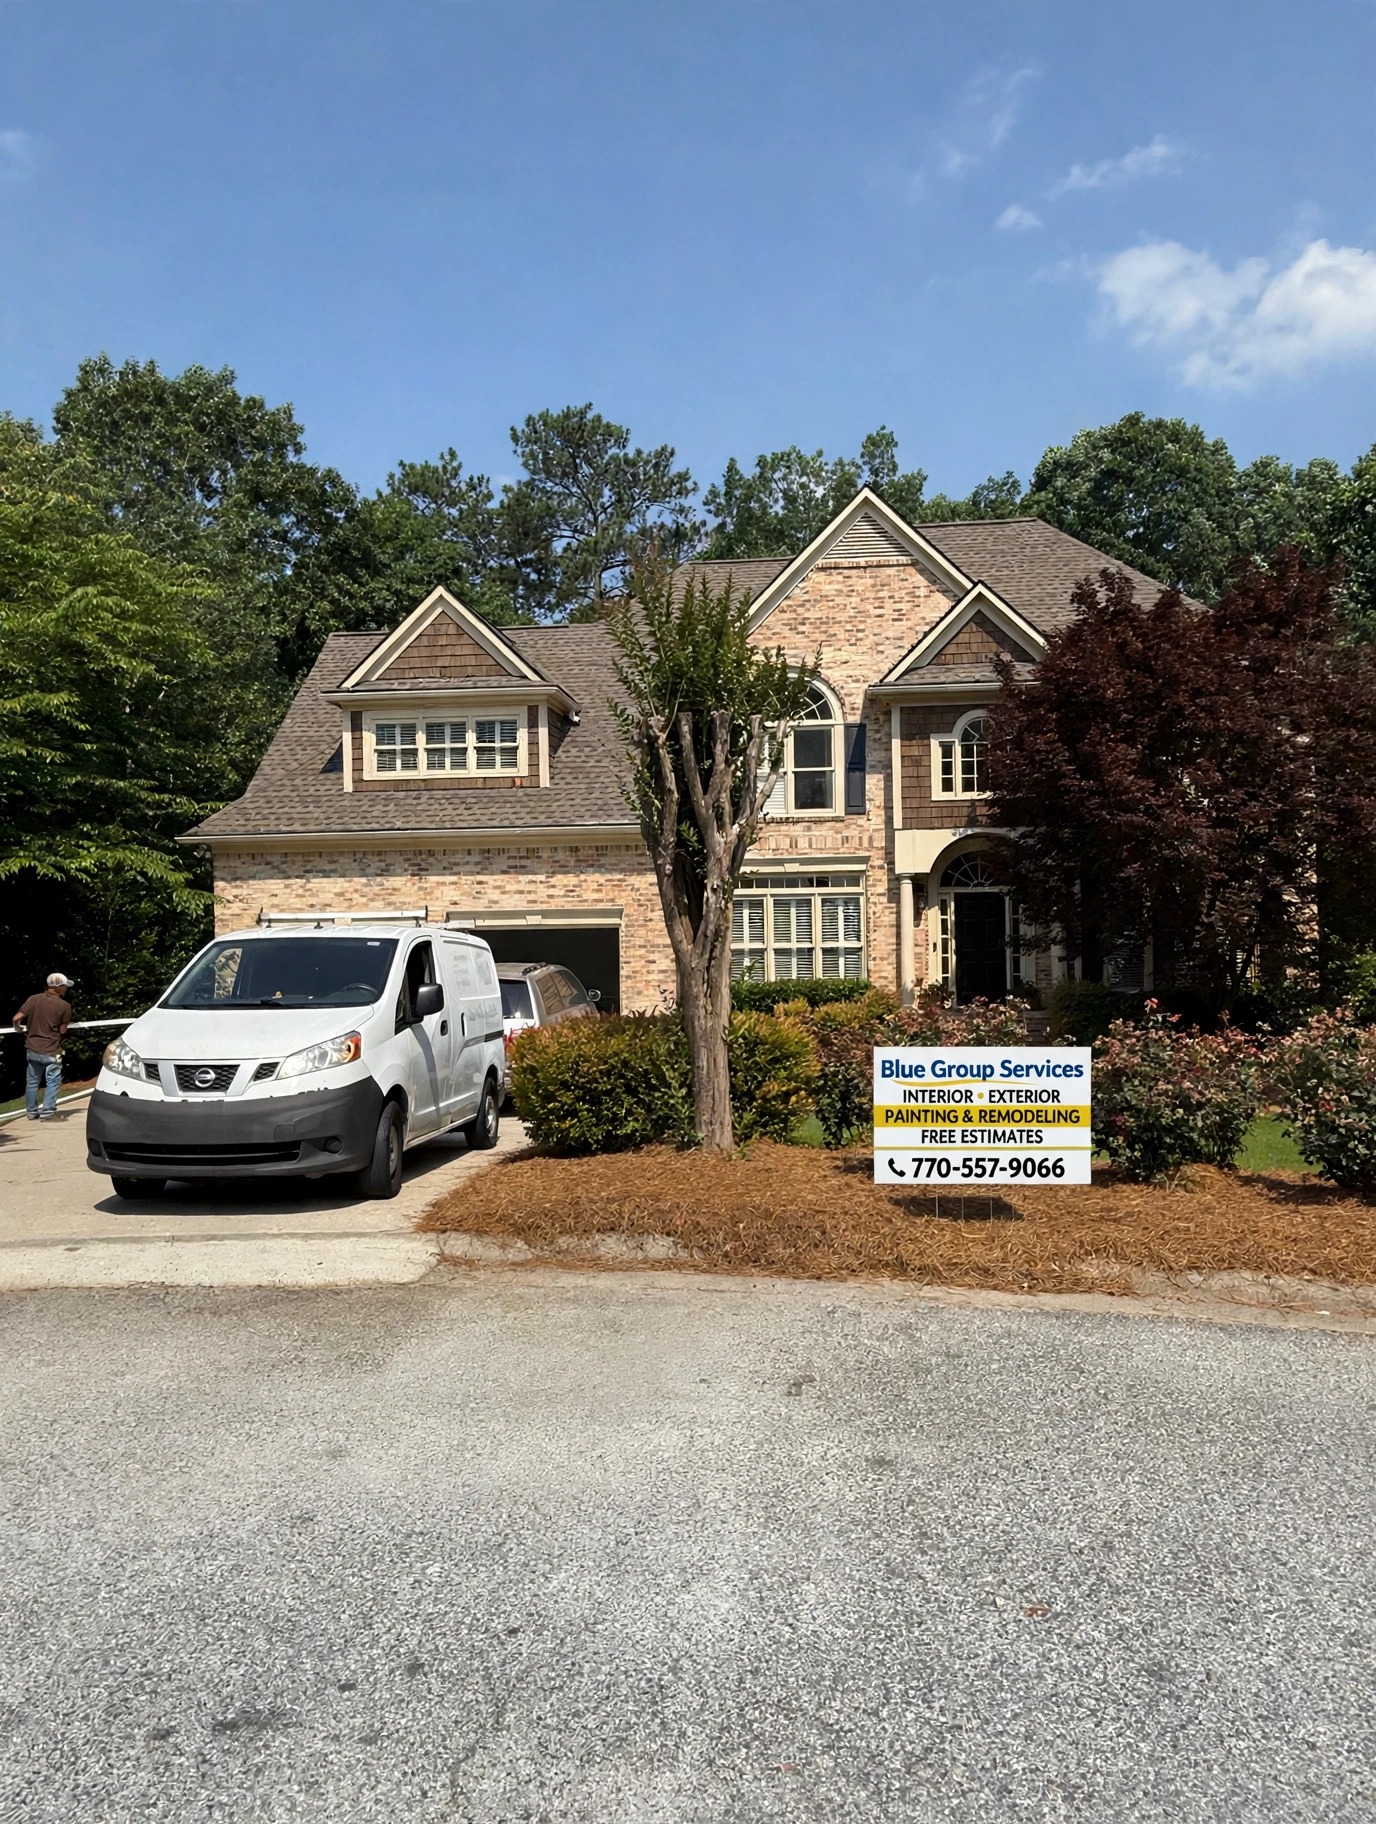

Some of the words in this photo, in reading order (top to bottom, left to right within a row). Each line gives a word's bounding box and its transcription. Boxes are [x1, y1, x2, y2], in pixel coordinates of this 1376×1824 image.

[881, 1059, 926, 1078] Blue
[931, 1059, 995, 1081] Group
[1000, 1059, 1084, 1078] Services
[903, 1089, 974, 1103] INTERIOR
[988, 1089, 1061, 1103] EXTERIOR
[885, 1109, 959, 1123] PAINTING
[962, 1110, 974, 1123] &
[978, 1109, 1081, 1123] REMODELING
[921, 1129, 957, 1144] FREE
[961, 1129, 1043, 1144] ESTIMATES
[911, 1157, 1065, 1178] 770-557-9066
